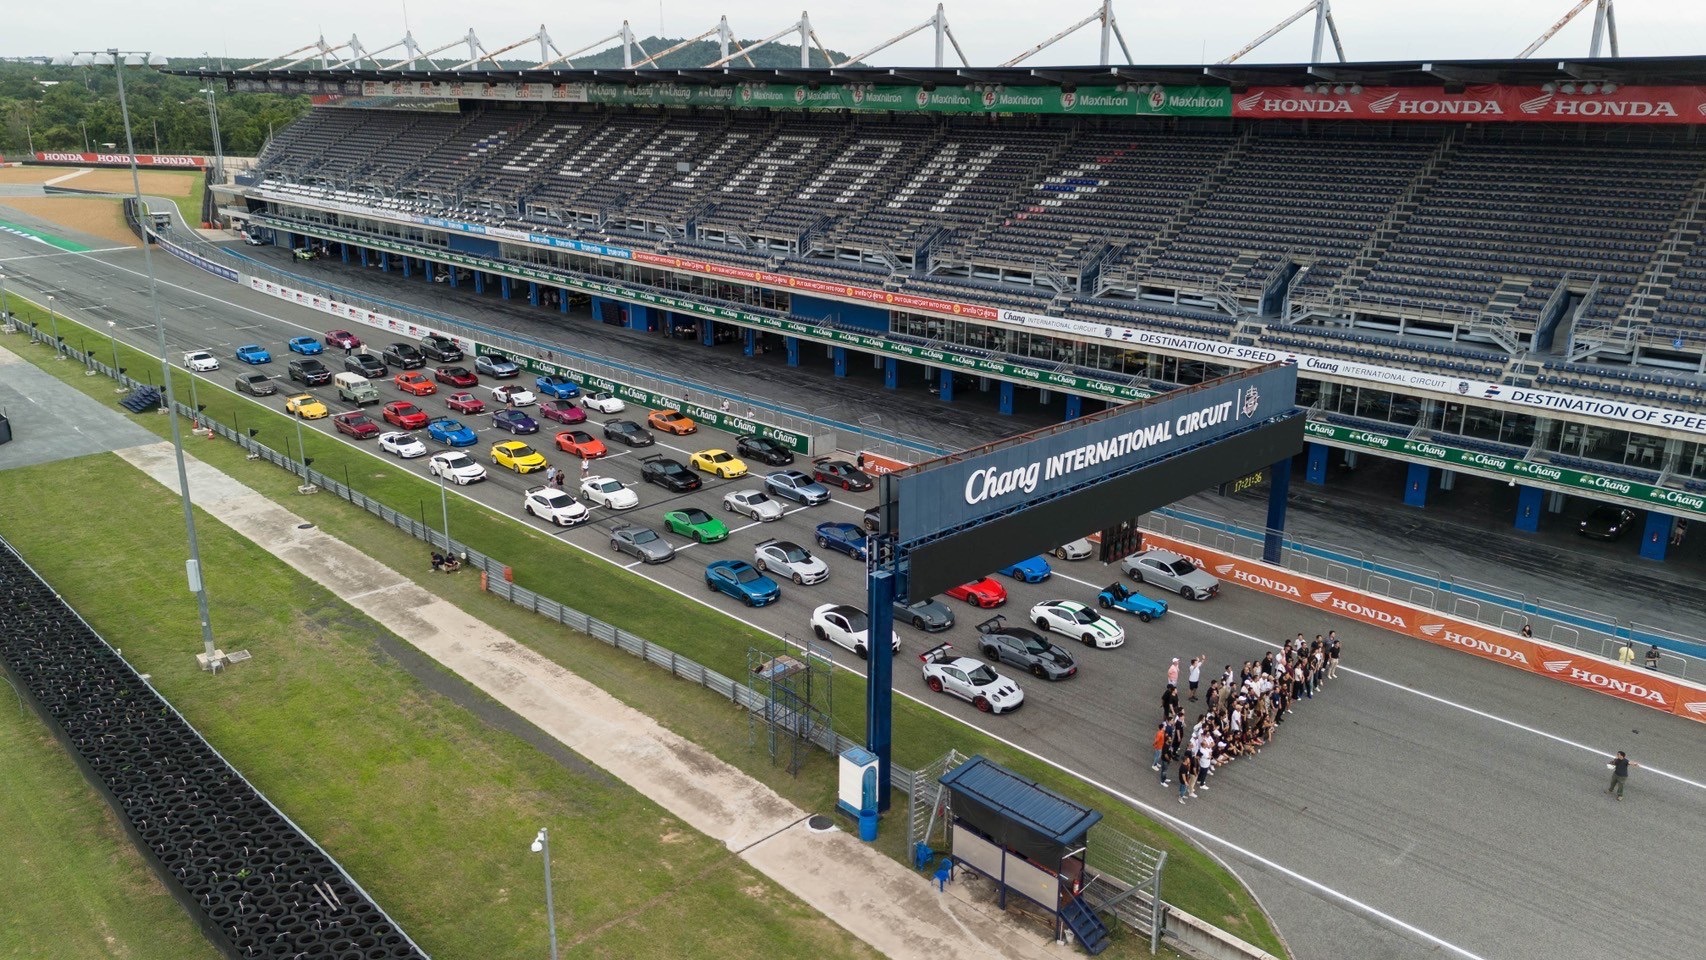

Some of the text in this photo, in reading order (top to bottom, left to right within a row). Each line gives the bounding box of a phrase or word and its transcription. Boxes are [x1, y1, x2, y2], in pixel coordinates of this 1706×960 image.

[931, 94, 970, 104] Maxnitron
[1000, 95, 1043, 106] Maxnitron
[1080, 96, 1128, 106] Maxnitron
[1169, 96, 1224, 108] Maxnitron
[1263, 99, 1354, 112] HONDA
[1398, 100, 1504, 114] HONDA
[1554, 101, 1678, 116] HONDA
[44, 152, 84, 162] HONDA
[152, 156, 196, 166] HONDA
[502, 124, 1005, 212] BURIRAM
[726, 309, 738, 318] Chang
[748, 314, 760, 323] Chang
[769, 318, 782, 328] Chang
[794, 323, 806, 332] Chang
[1003, 312, 1098, 333] Chang INTERNATIONAL CIRCUIT
[819, 328, 832, 338] Chang
[846, 333, 859, 343] Chang
[870, 338, 884, 348] Chang
[898, 343, 913, 354] Chang
[1140, 333, 1276, 362] DESTINATION OF SPEED
[512, 354, 528, 368] Chang
[928, 348, 943, 360] Chang
[960, 356, 975, 366] Chang
[539, 362, 556, 375] Chang
[988, 361, 1004, 372] Chang
[1022, 368, 1040, 379] Chang
[1306, 358, 1446, 388] Chang INTERNATIONAL CIRCUIT
[566, 369, 584, 384] Chang
[1058, 374, 1076, 386] Chang
[596, 378, 614, 393] Chang
[1096, 382, 1116, 394] Chang
[628, 387, 647, 402] Chang
[660, 396, 680, 412] Chang
[1510, 390, 1706, 430] DESTINATION OF SPEE
[696, 407, 717, 423] Chang
[734, 417, 756, 434] Chang
[1309, 422, 1335, 436] Chang
[773, 430, 797, 446] Chang
[1362, 432, 1388, 446] Chang
[965, 462, 1040, 505] Chang
[1045, 420, 1172, 480] INTERNATIONAL
[1176, 401, 1232, 436] CIRCUIT
[1416, 444, 1446, 458] Chang
[1475, 454, 1506, 470] Chang
[1528, 464, 1562, 480] Chang
[1596, 477, 1630, 494] Chang
[1666, 492, 1704, 509] Chang
[1234, 569, 1302, 598] HONDA
[1331, 597, 1407, 628] HONDA
[1443, 630, 1529, 665] HONDA
[1570, 668, 1667, 705] HONDA
